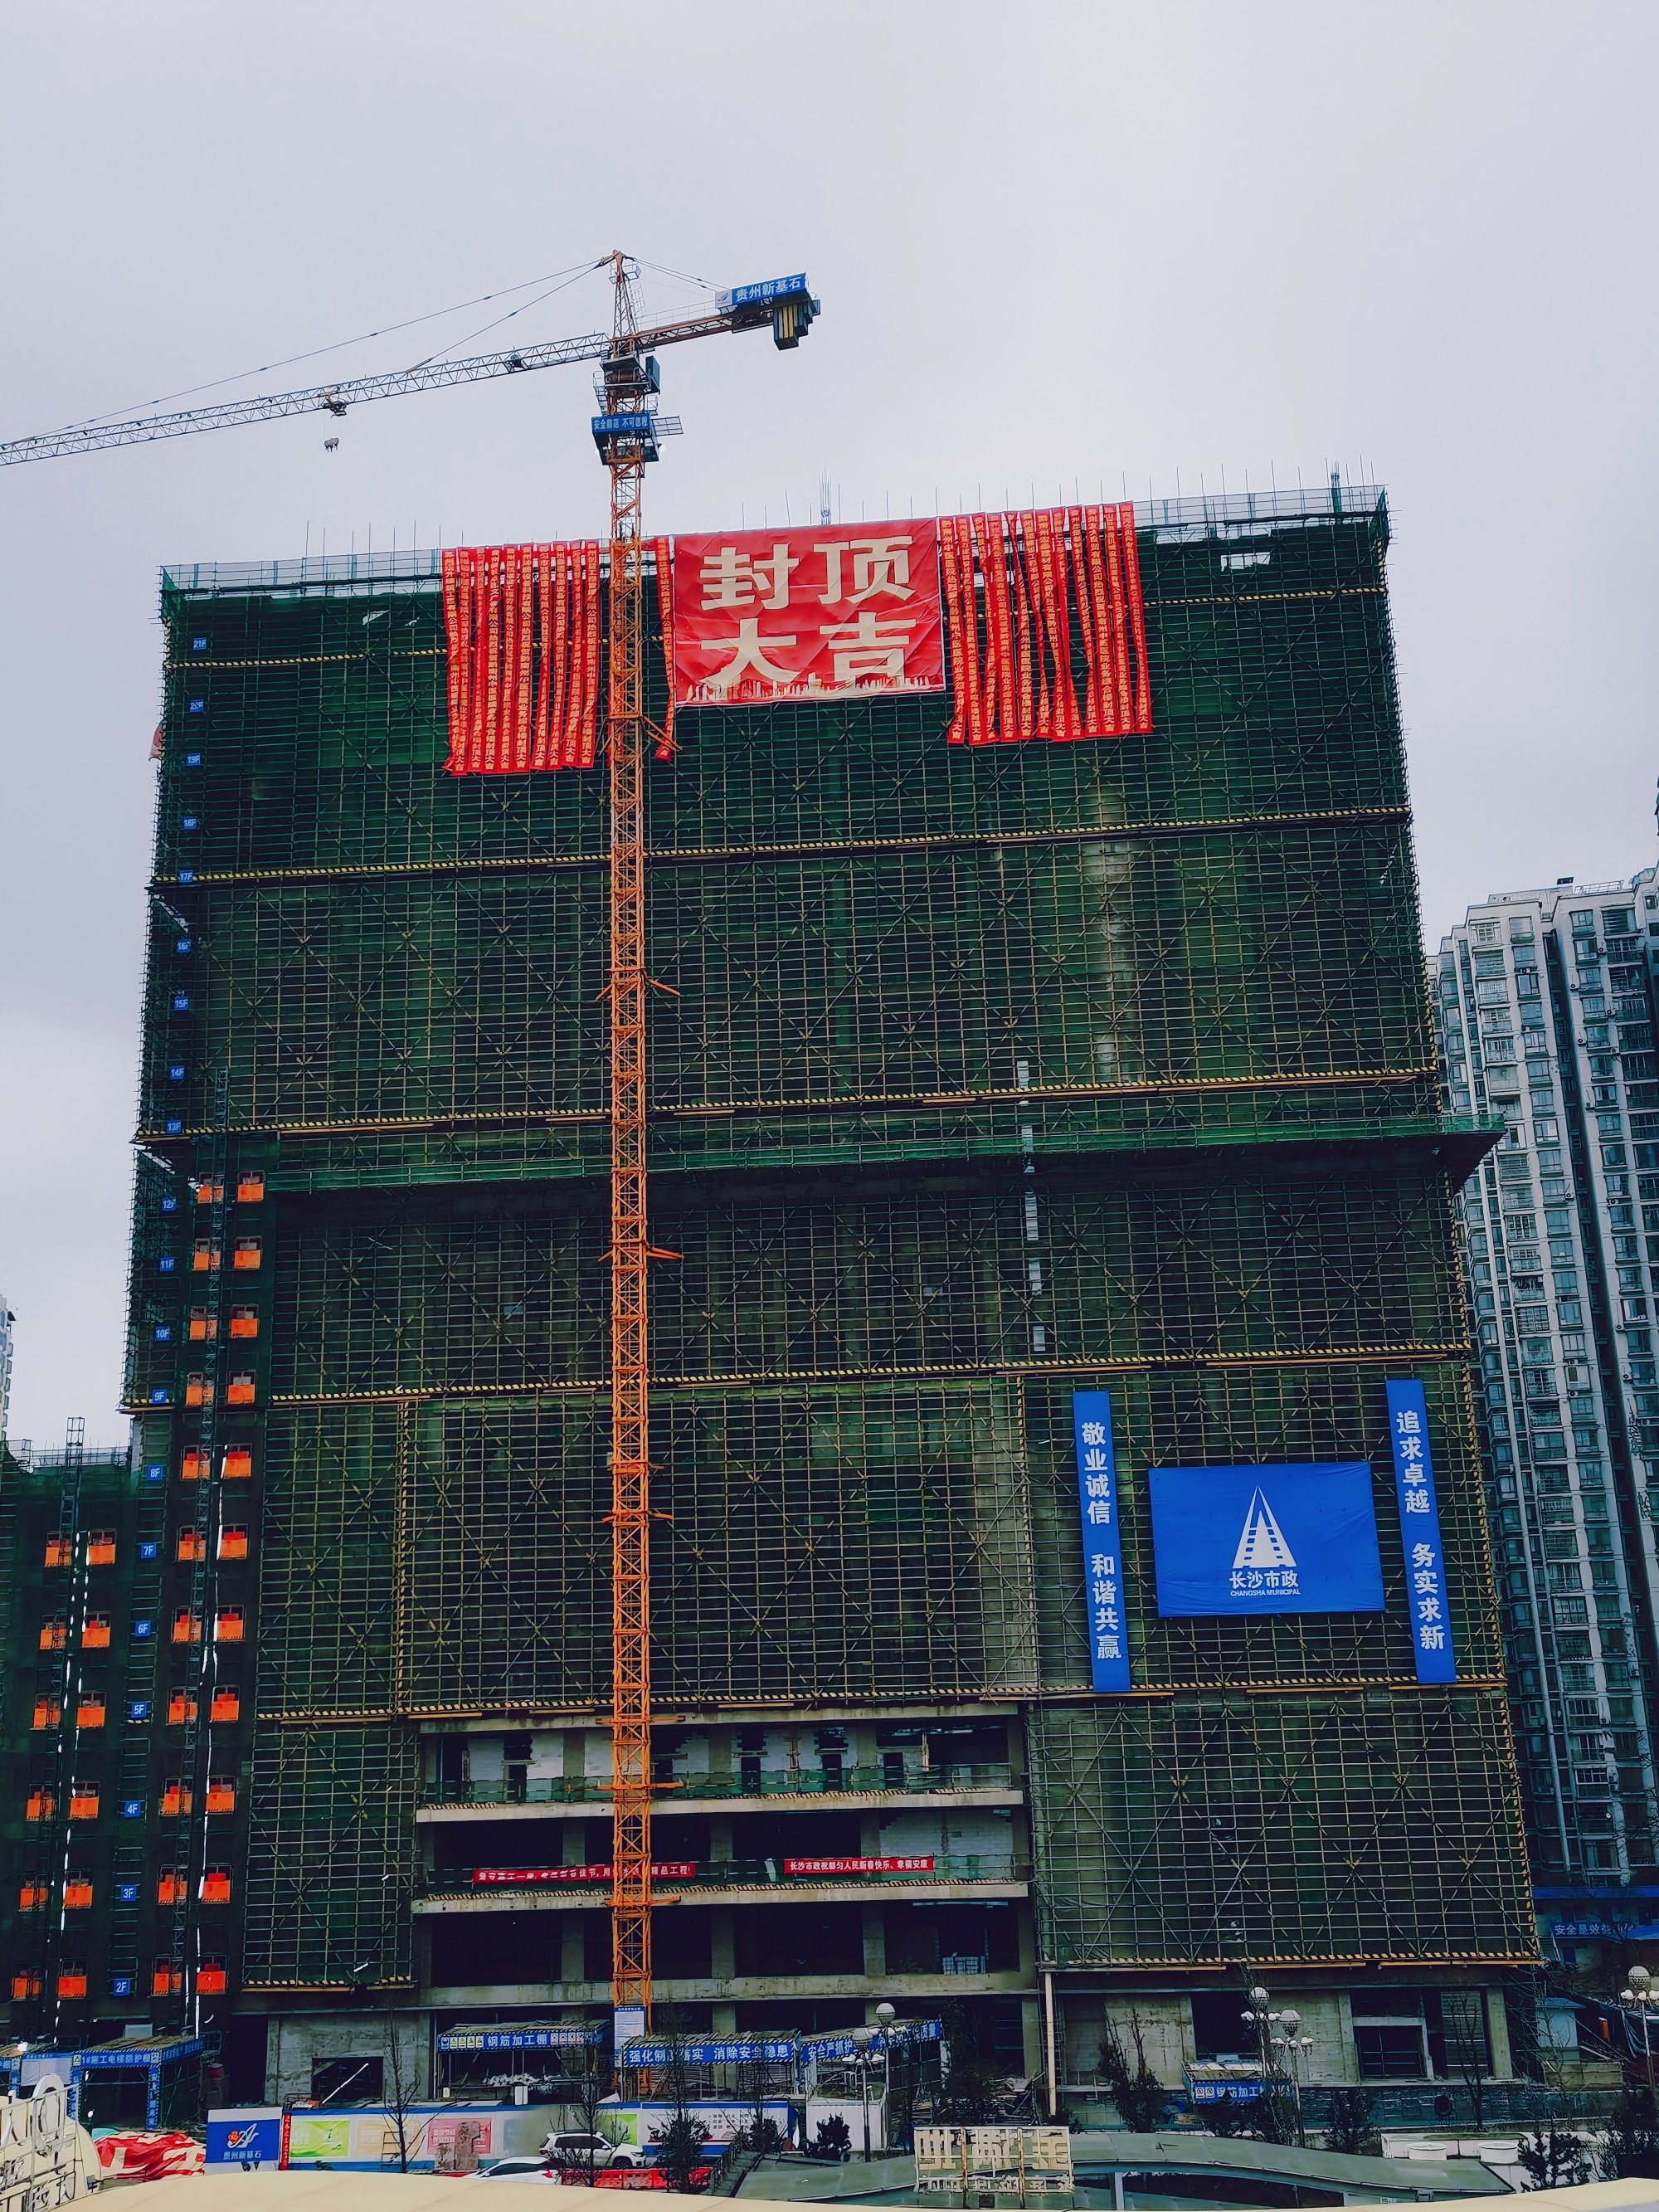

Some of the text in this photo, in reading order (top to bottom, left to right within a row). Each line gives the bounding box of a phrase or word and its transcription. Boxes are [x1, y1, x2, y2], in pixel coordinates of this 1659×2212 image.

[736, 276, 801, 301] 贵州新基石
[699, 535, 917, 611] 封顶
[193, 639, 207, 648] 21F
[699, 611, 917, 690] 大吉
[187, 755, 200, 763] 19F
[183, 818, 197, 827] 18F
[180, 872, 193, 880] 17F
[175, 999, 188, 1008] 15F
[171, 1068, 184, 1077] 14F
[168, 1122, 181, 1131] 13F
[163, 1199, 176, 1208] 12F
[160, 1259, 173, 1269] 11F
[156, 1328, 169, 1338] 10F
[154, 1391, 165, 1401] 9F
[150, 1468, 160, 1477] 8F
[1396, 1410, 1445, 1650] 追求卓越 务实求新
[1081, 1421, 1121, 1659] 敬业诚信 和谐共赢
[144, 1545, 153, 1556] 7F
[1229, 1570, 1298, 1589] 长沙市政
[138, 1624, 148, 1634] 6F
[134, 1704, 144, 1714] 5F
[127, 1804, 138, 1814] 4F
[124, 1888, 134, 1898] 3F
[116, 1982, 126, 1992] 2F
[487, 2034, 547, 2047] 钢筋加工棚
[629, 2045, 789, 2063] 强化制落实 消除安全隐患
[1217, 2086, 1264, 2098] 钢筋加工
[223, 2150, 262, 2161] 贵州新基石
